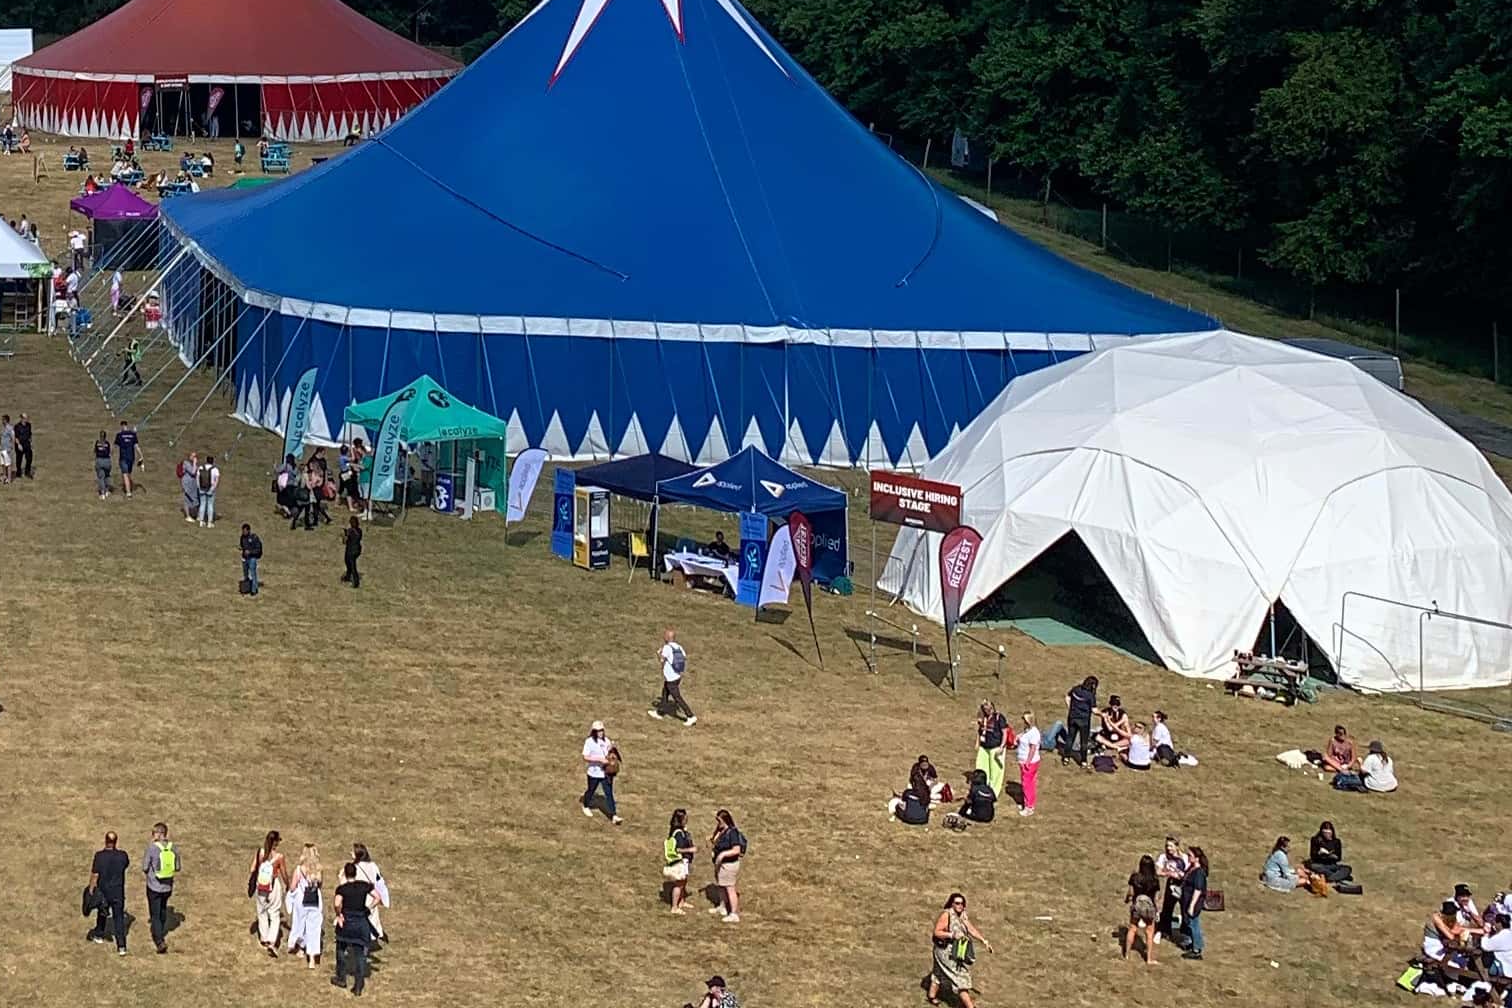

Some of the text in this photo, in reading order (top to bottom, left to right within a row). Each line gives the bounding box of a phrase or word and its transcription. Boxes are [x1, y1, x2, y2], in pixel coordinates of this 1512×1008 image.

[873, 481, 958, 507] INCLUSIVE HIRING
[898, 498, 931, 513] STAGE
[800, 525, 809, 568] RECFEST
[949, 538, 974, 589] RECFEST
